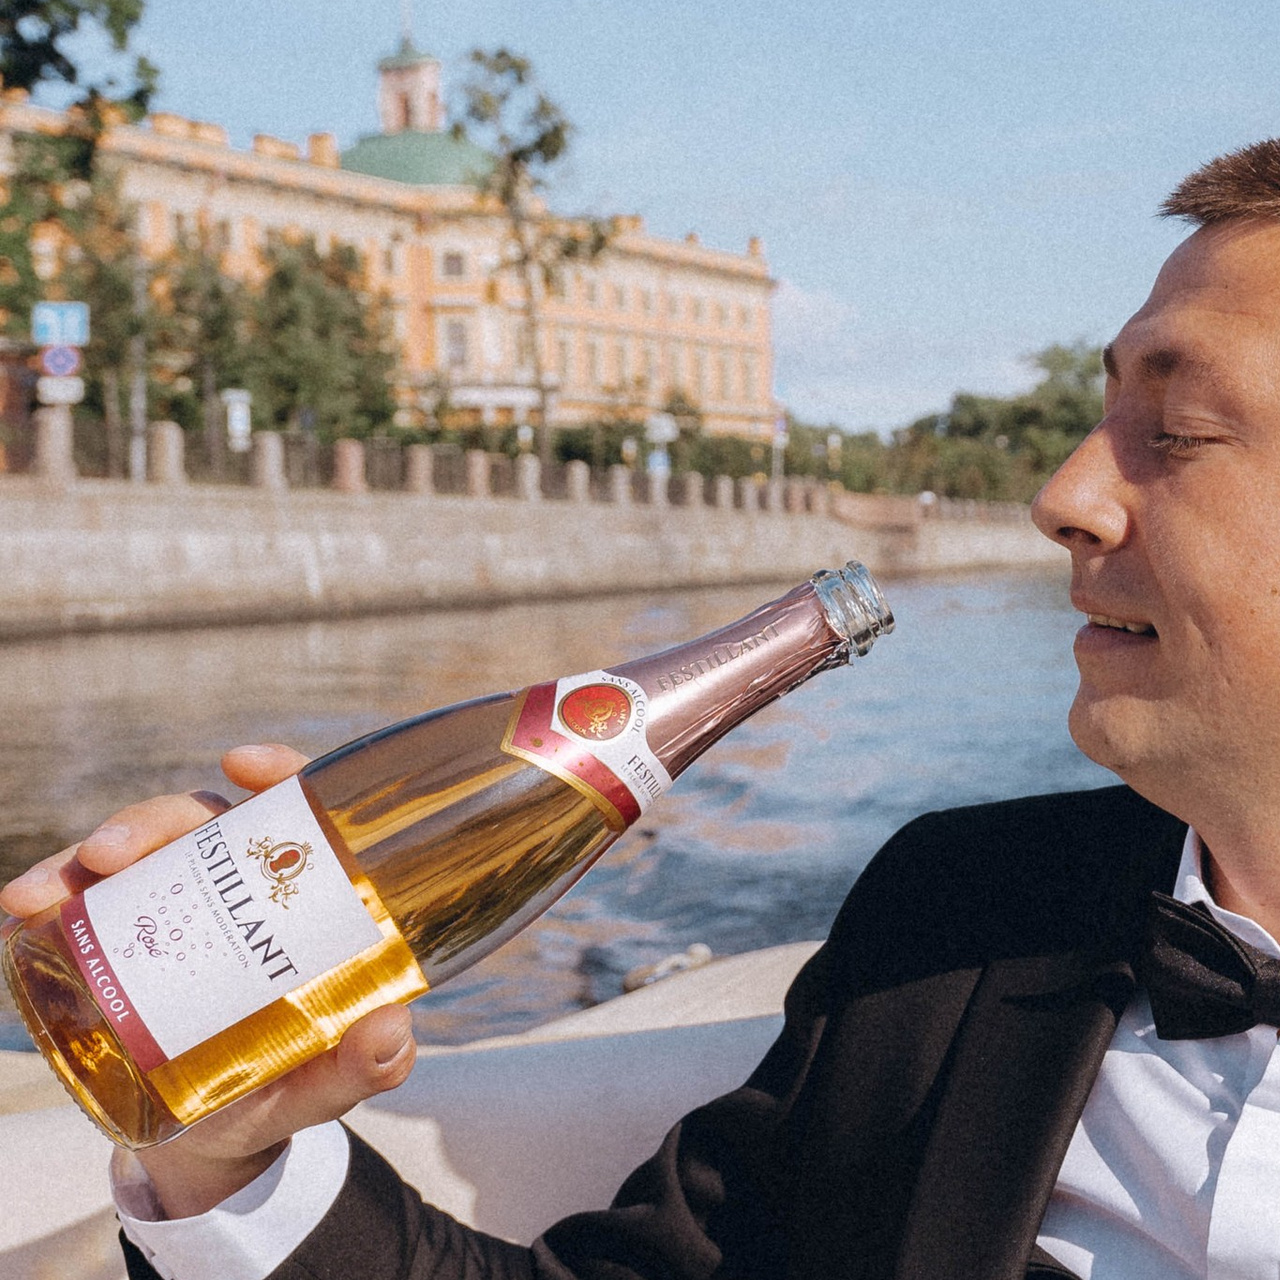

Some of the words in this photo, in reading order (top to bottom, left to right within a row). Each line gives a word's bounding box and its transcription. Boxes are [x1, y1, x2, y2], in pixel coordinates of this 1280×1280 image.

[656, 624, 780, 692] FESTILLANT
[629, 689, 646, 733] ALCOOL
[189, 858, 205, 886] PLAISIR
[199, 886, 215, 908] SANS
[194, 822, 299, 981] FESTILLANT
[133, 915, 169, 958] Rosé
[71, 919, 95, 955] SANS
[86, 958, 130, 1023] ALCOOL
